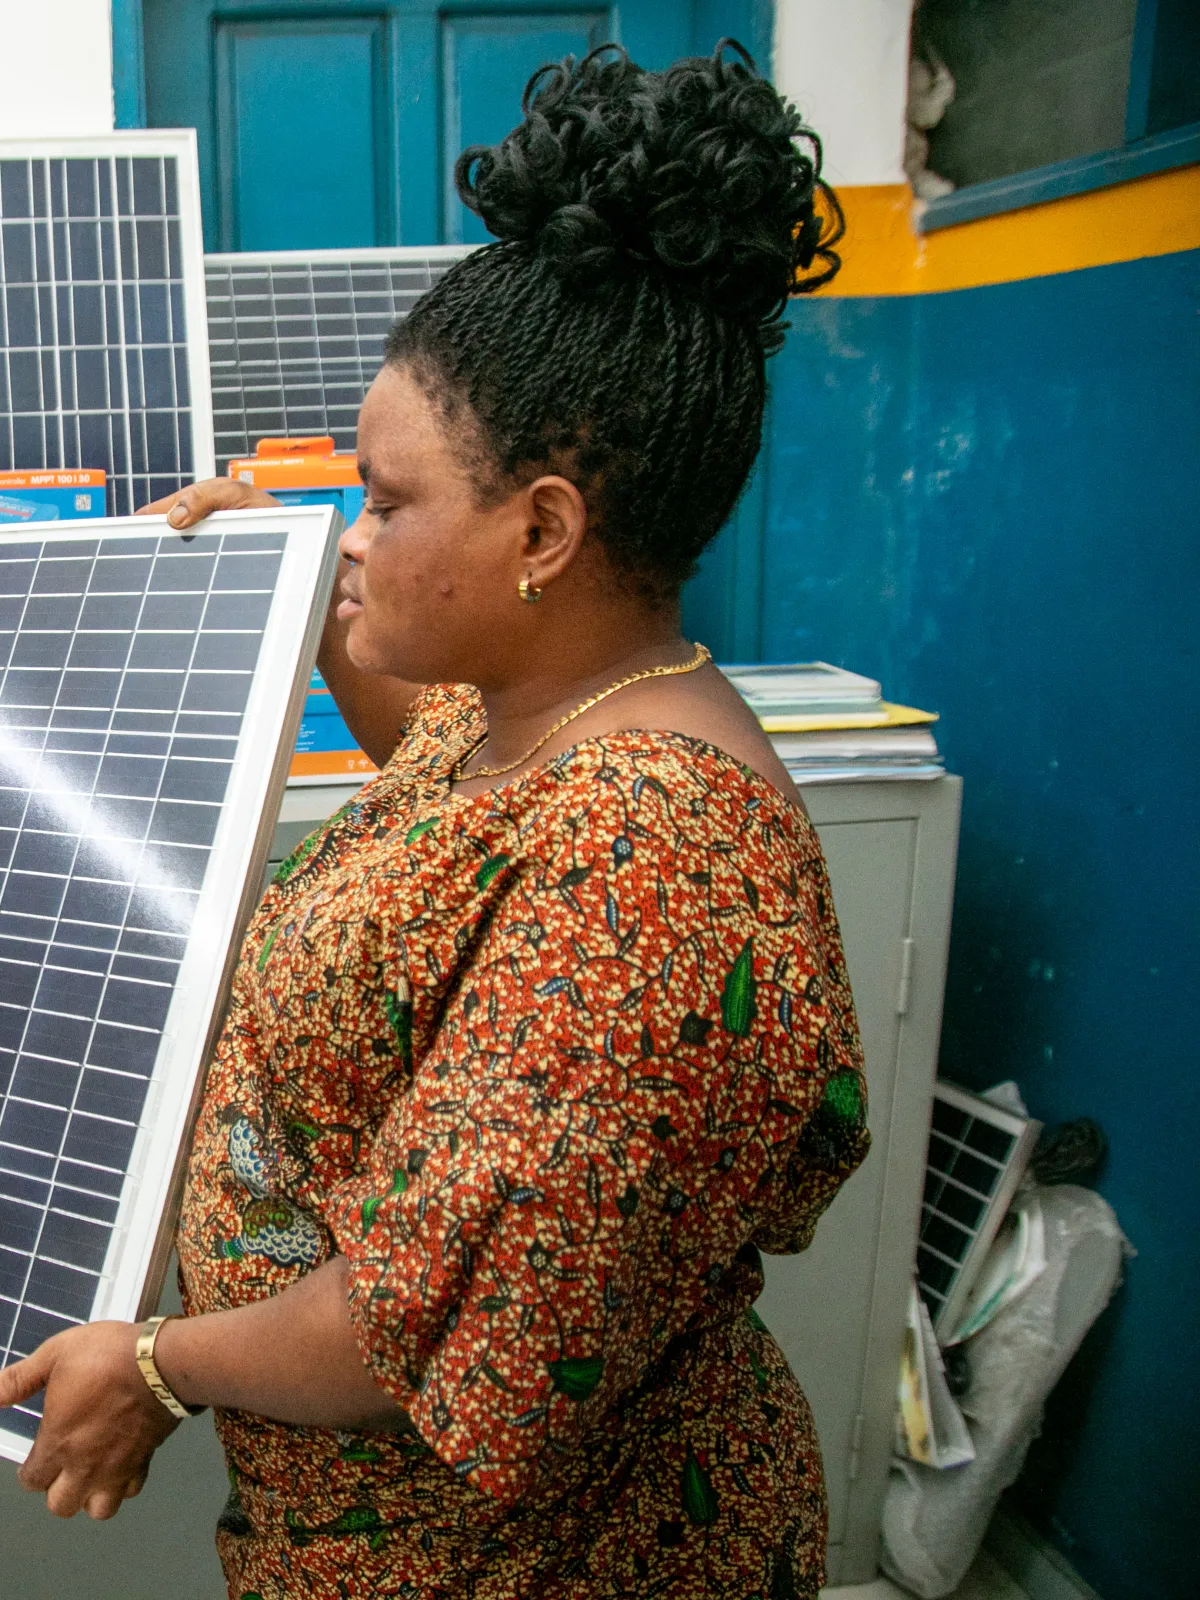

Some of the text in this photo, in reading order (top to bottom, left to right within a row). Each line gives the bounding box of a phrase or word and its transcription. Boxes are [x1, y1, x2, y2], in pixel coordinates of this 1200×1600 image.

[30, 475, 55, 485] MPPT
[57, 474, 73, 484] 100
[78, 473, 91, 484] 30
